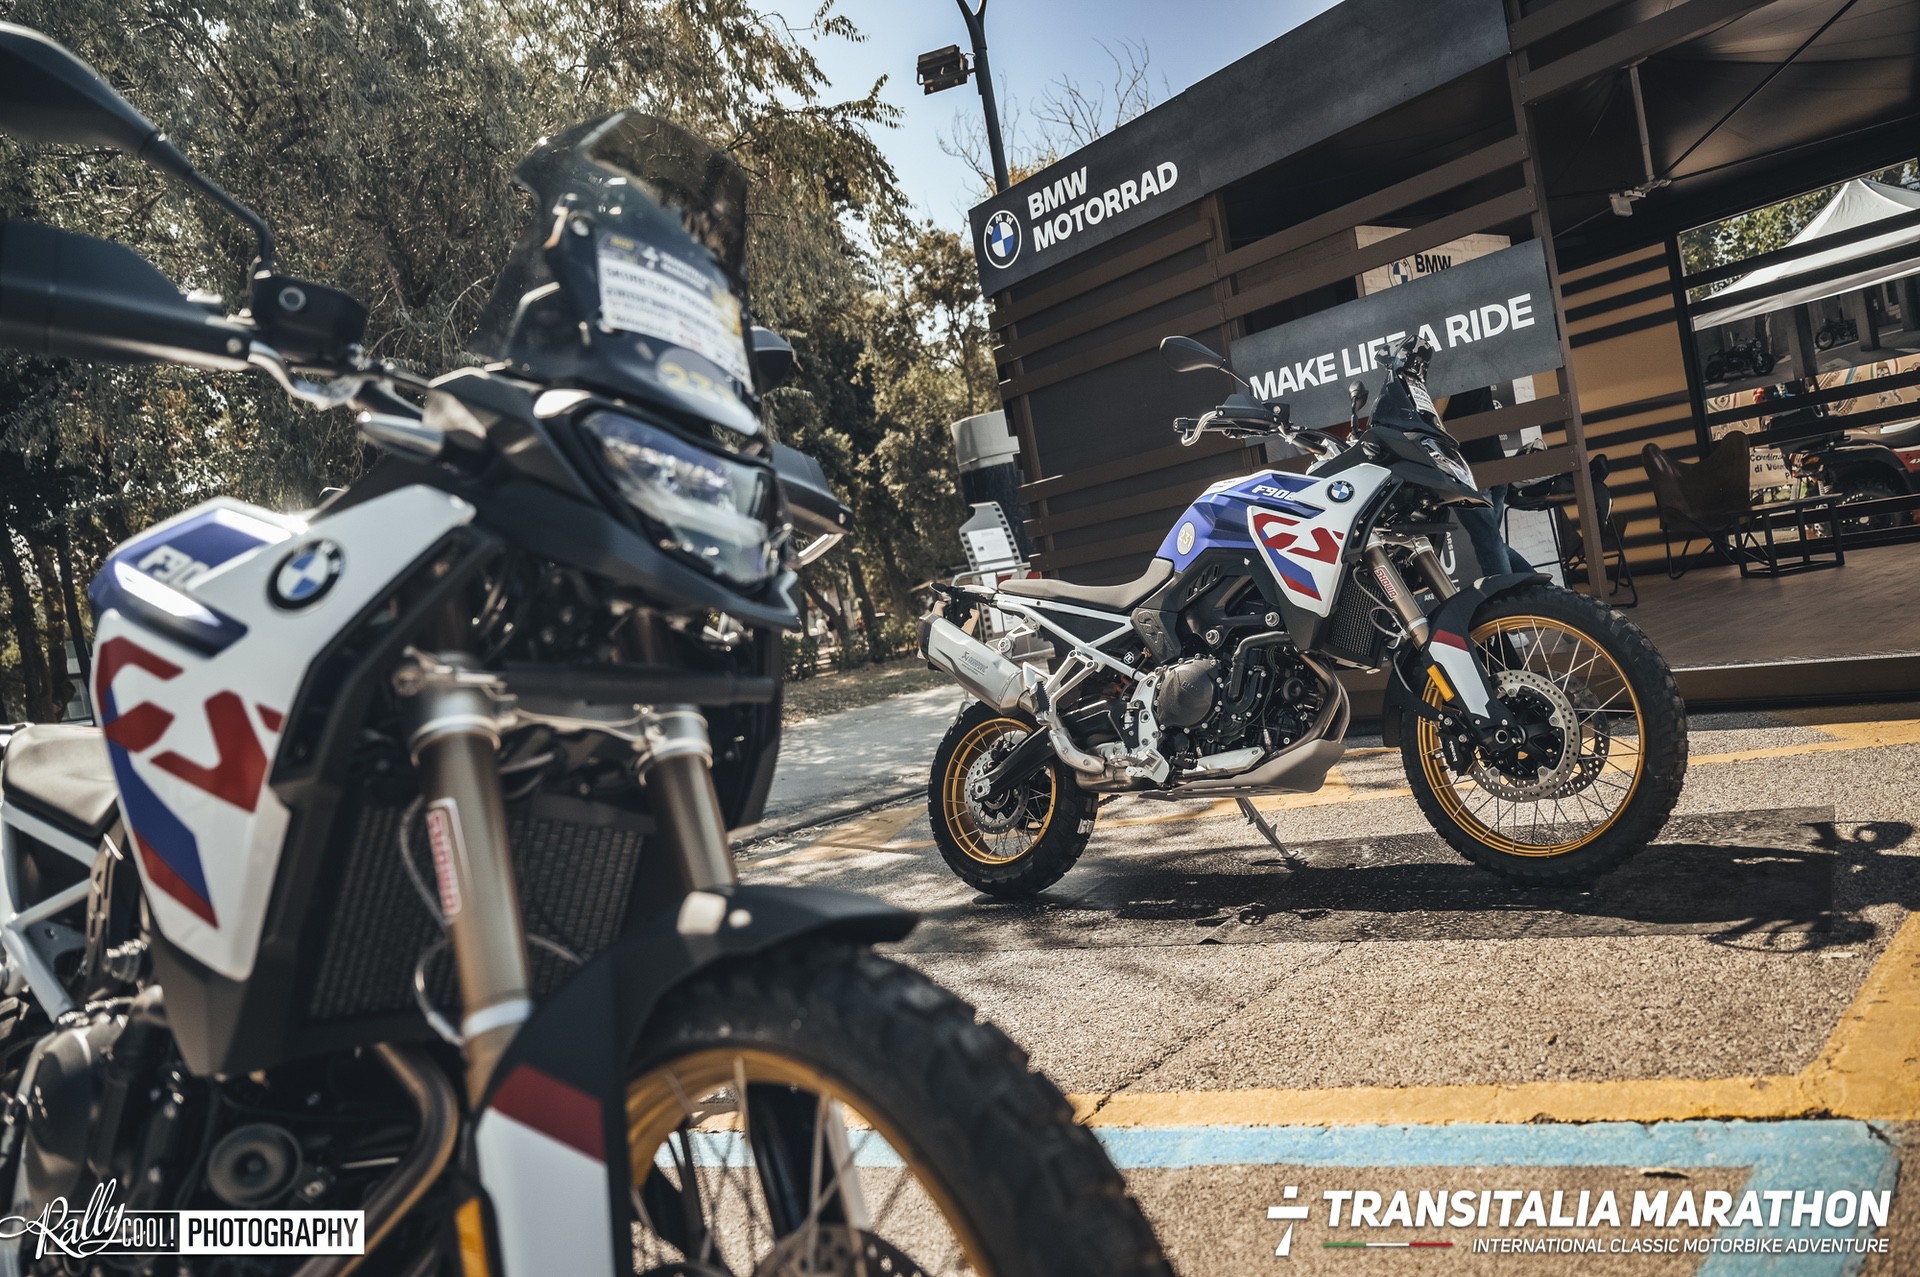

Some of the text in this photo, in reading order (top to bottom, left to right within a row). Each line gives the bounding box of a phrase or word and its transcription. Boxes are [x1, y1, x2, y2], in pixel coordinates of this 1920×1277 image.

[1027, 166, 1088, 220] BMW
[1032, 161, 1179, 252] MOTORRAD
[1414, 254, 1451, 273] BMW
[1250, 352, 1338, 401] MAKE
[1445, 293, 1535, 348] RIDE
[1375, 568, 1398, 598] SHOWA
